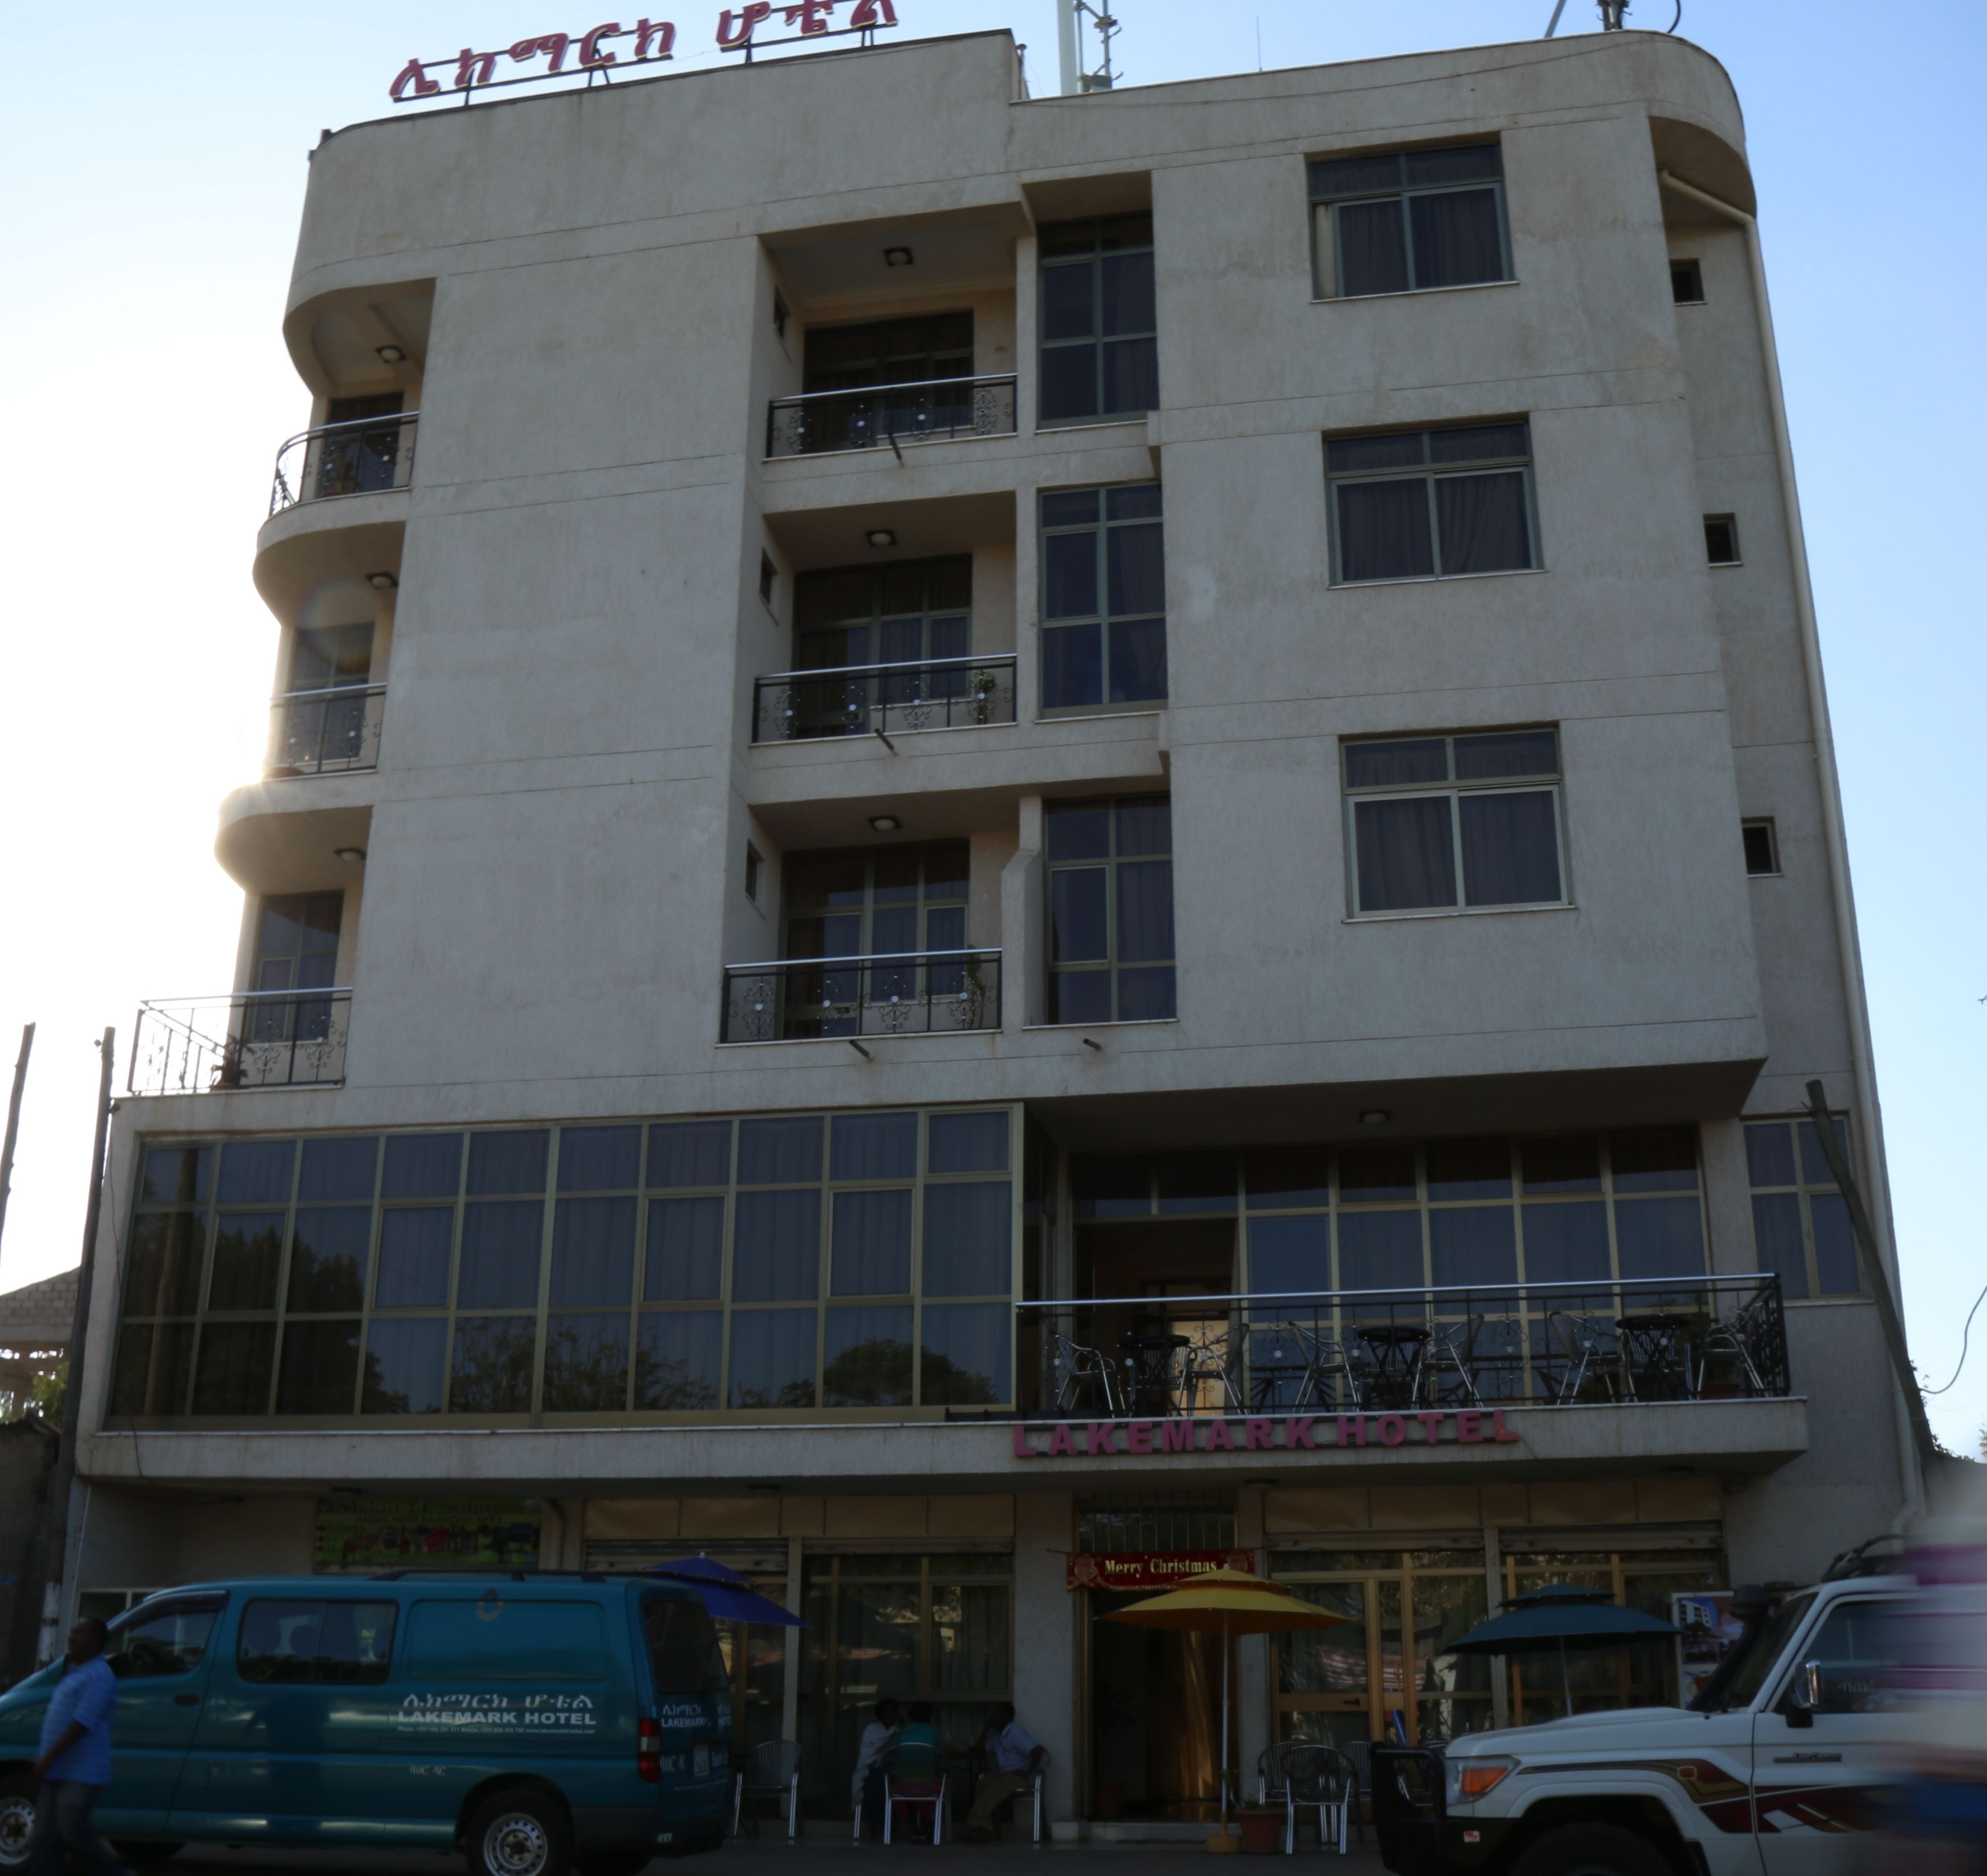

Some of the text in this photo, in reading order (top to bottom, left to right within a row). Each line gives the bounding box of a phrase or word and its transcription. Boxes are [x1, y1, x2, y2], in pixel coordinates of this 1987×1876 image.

[1014, 1409, 1519, 1457] LAKEMARK HOTEL
[1105, 1559, 1217, 1578] Merry Christmas
[398, 1711, 597, 1725] LAKEMARK HOTEL
[662, 1717, 705, 1728] LAKEMARK
